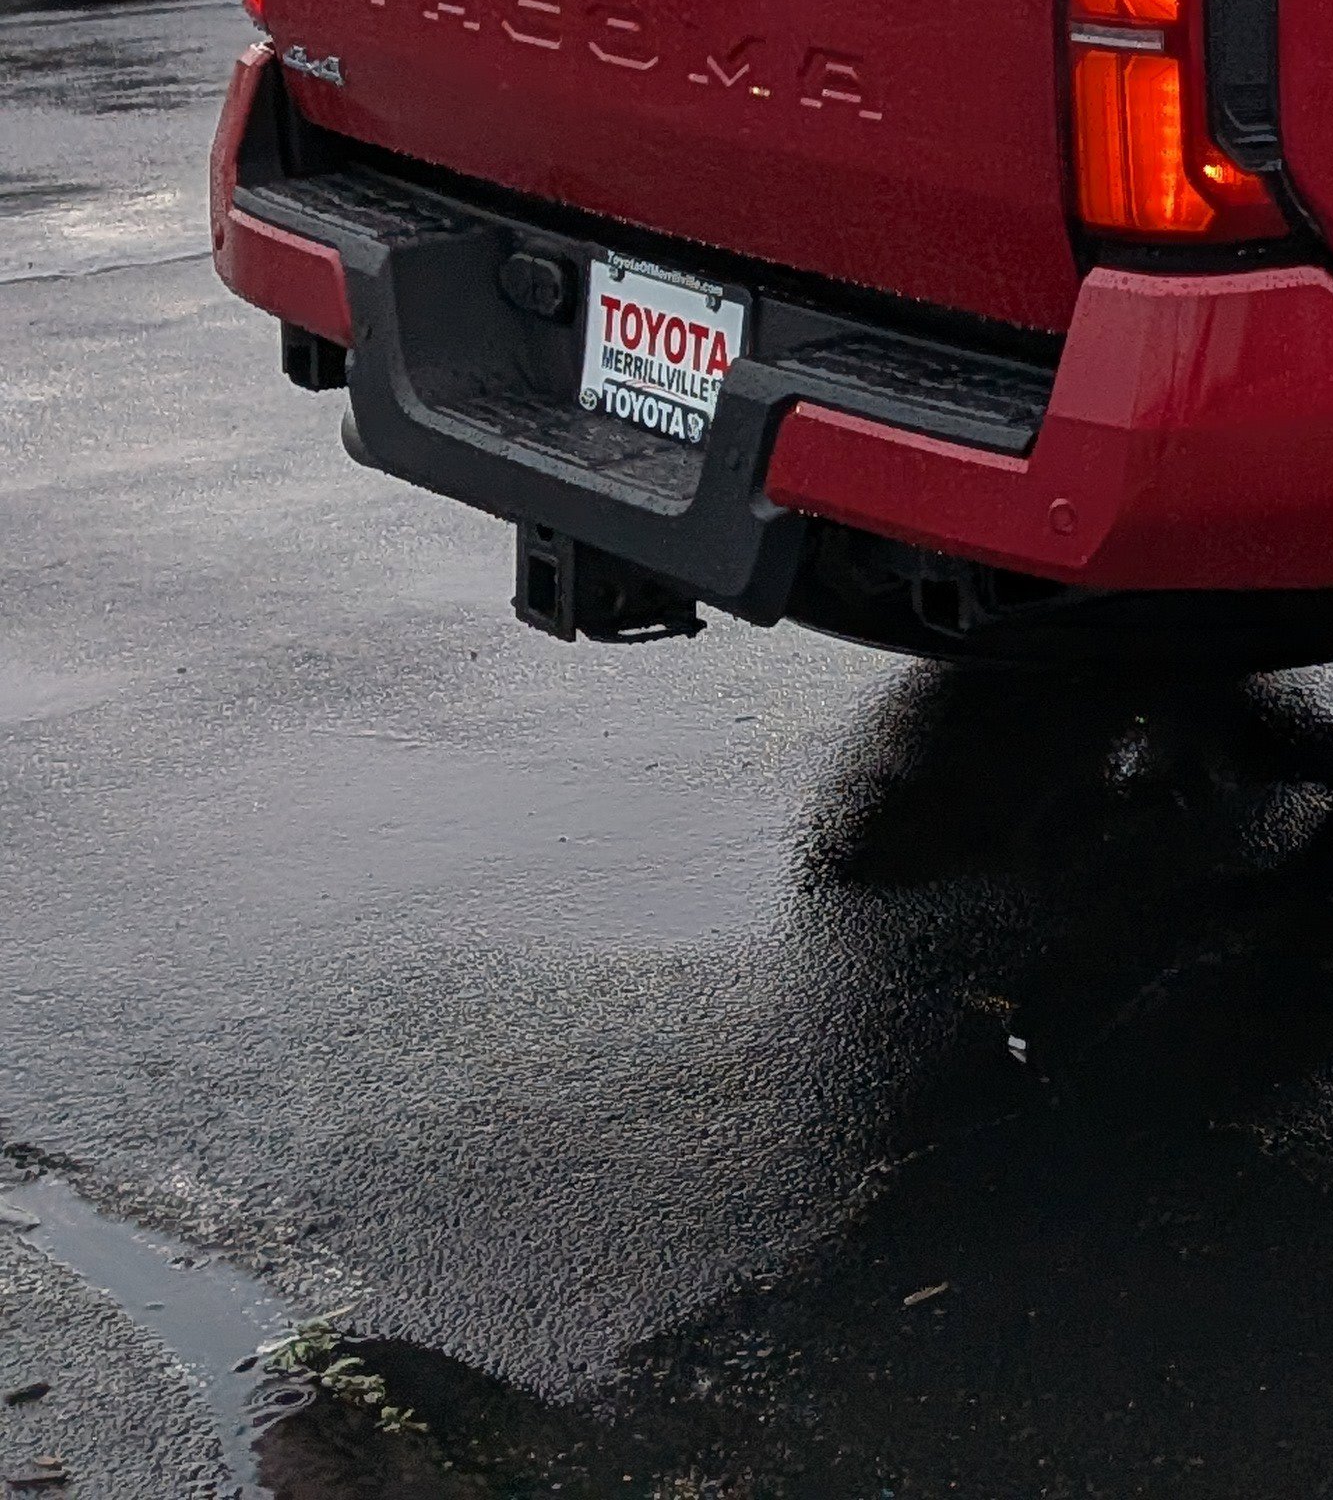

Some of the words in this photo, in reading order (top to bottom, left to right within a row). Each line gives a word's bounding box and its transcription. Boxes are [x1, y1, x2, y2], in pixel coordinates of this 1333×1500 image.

[601, 295, 731, 375] TOYOTA
[601, 345, 710, 402] MERRILLVILLE
[602, 382, 685, 439] TOYOTA
